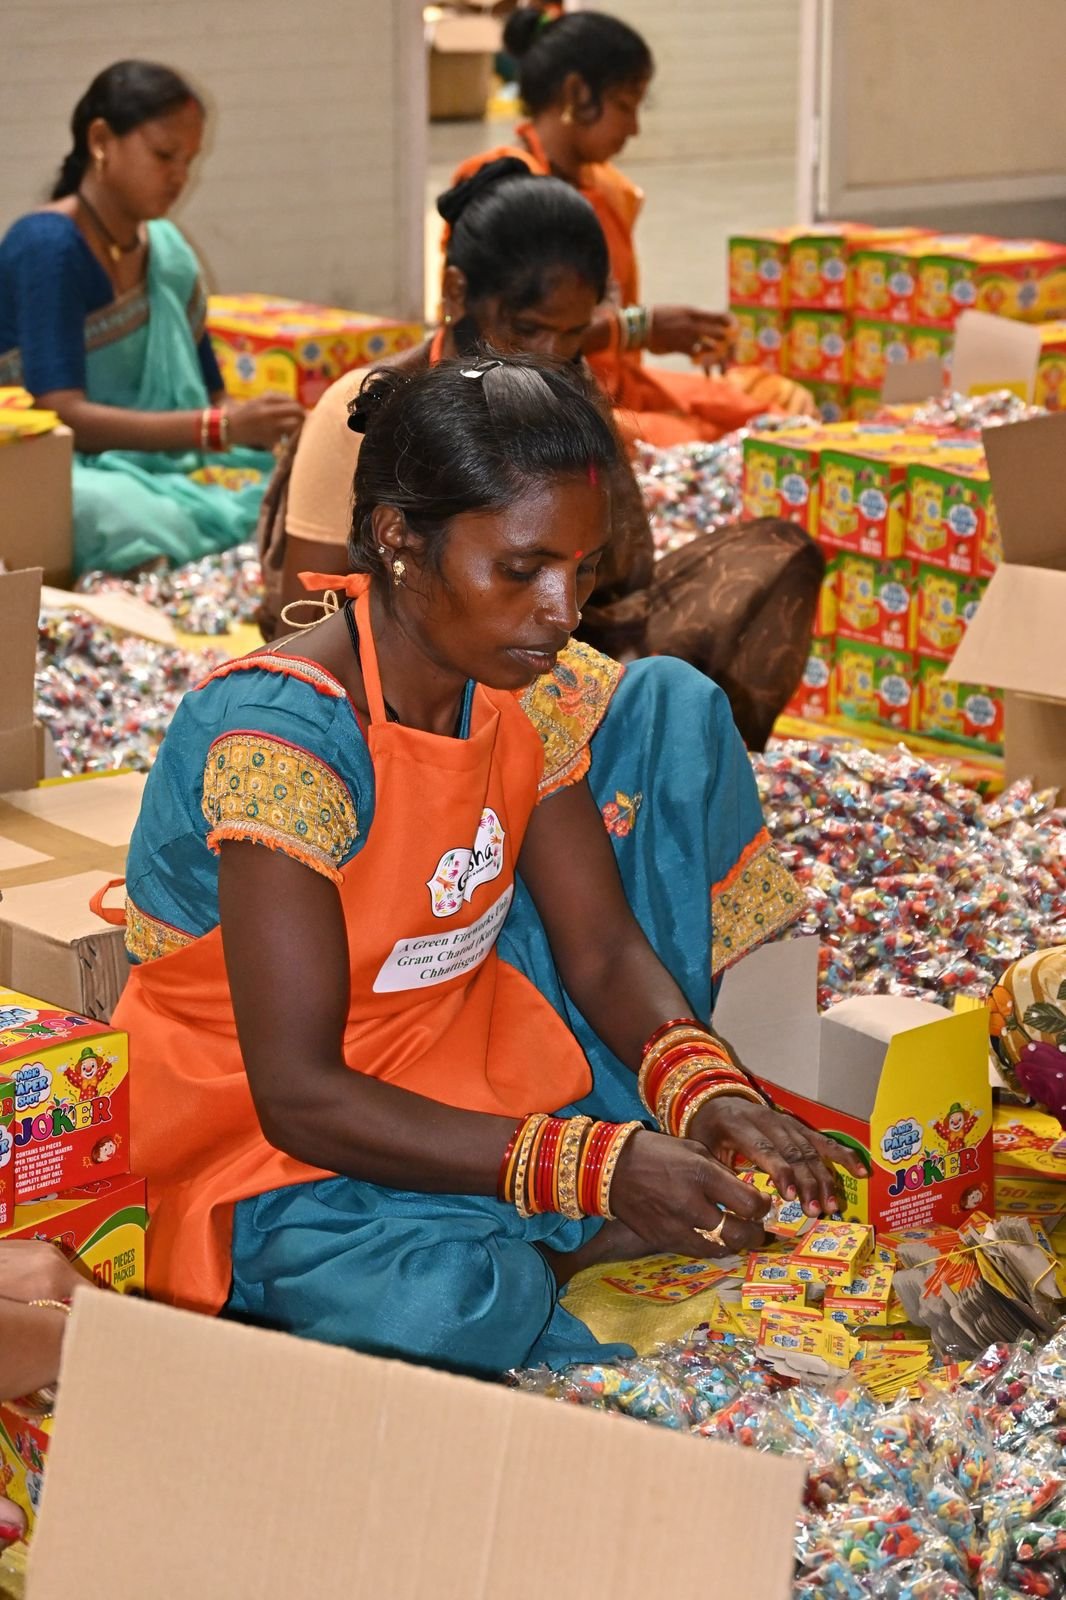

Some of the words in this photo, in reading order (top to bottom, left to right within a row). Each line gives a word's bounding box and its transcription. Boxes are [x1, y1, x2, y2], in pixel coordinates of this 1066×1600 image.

[399, 943, 409, 952] A
[412, 936, 449, 950] Green
[453, 913, 495, 945] Fireworks
[397, 955, 433, 967] Gram
[16, 1067, 40, 1083] MAGIC
[17, 1092, 41, 1108] SHOT
[14, 1096, 113, 1147] JOKER
[16, 1147, 39, 1159] CONTAINS
[45, 1141, 62, 1151] PIECES
[884, 1130, 921, 1153] PAPER
[22, 1164, 29, 1172] TO
[36, 1159, 48, 1168] SOLD
[28, 1170, 35, 1178] TO
[54, 1162, 61, 1170] AS
[888, 1147, 979, 1197] JOKER
[15, 1176, 40, 1188] COMPLETE
[36, 1177, 62, 1189] CAREFULLY
[113, 1248, 136, 1270] PIECES
[113, 1264, 136, 1286] PACKED
